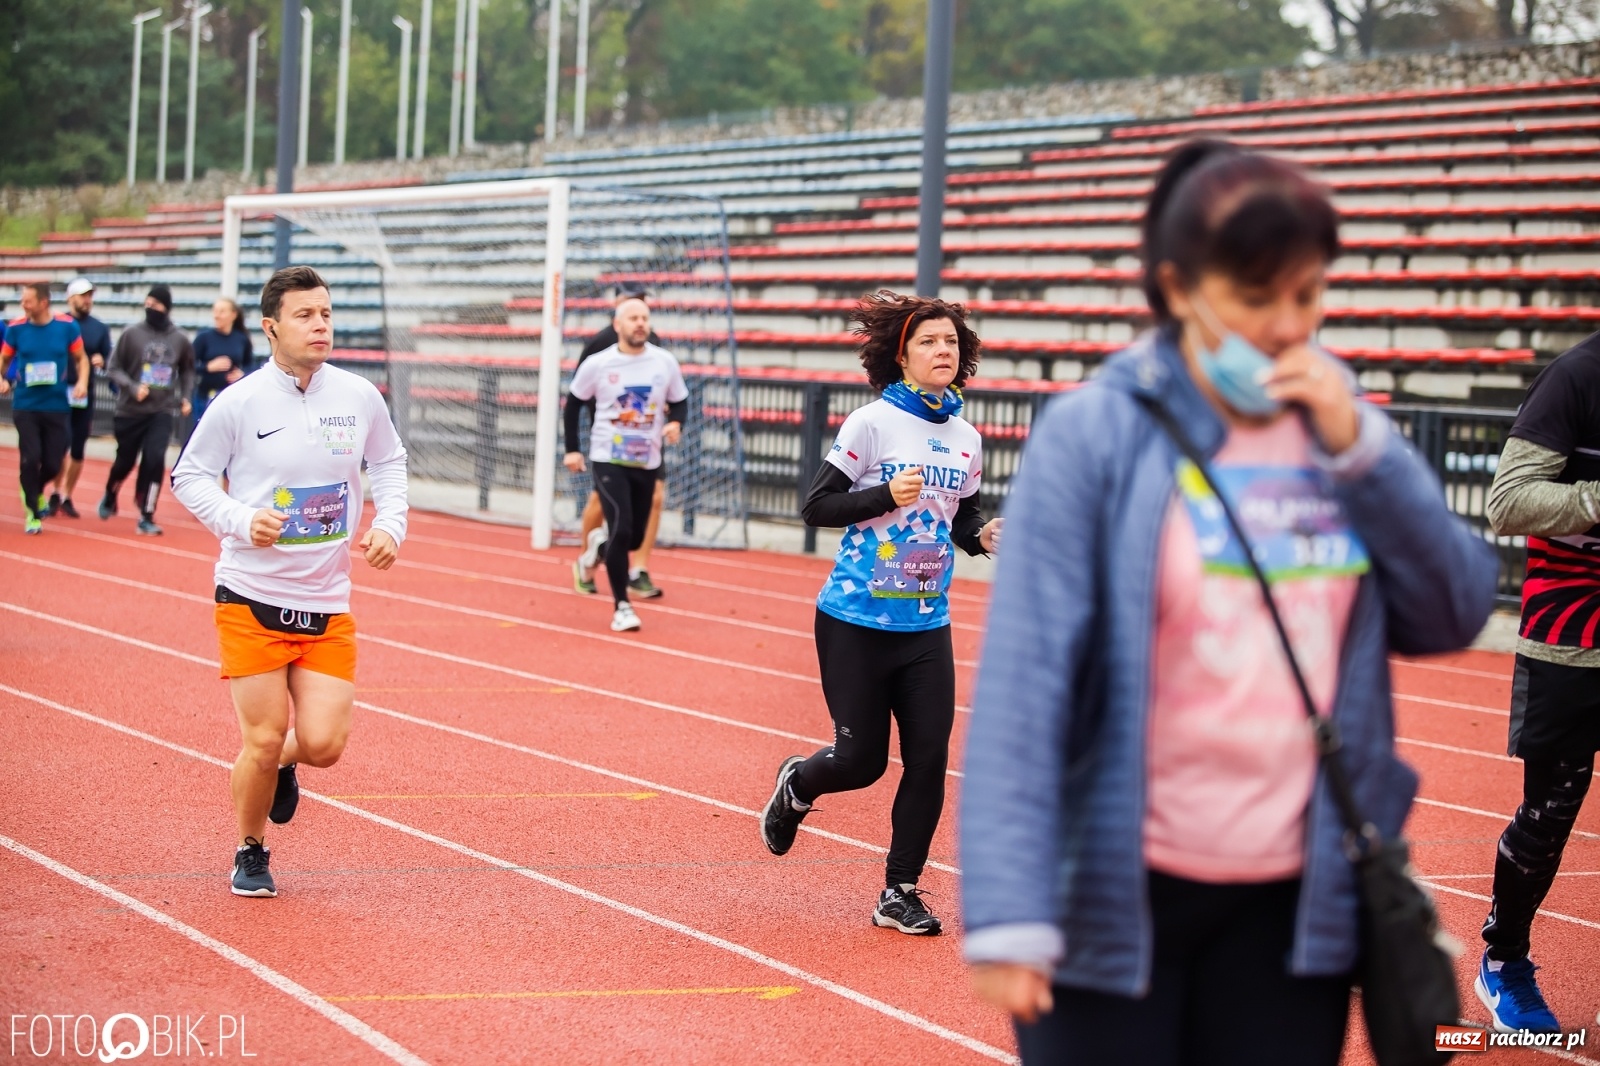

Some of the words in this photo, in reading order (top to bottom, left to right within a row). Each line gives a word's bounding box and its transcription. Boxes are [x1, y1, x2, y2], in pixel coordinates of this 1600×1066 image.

[320, 416, 356, 427] MATEUSZ
[304, 507, 317, 515] DLA
[320, 521, 342, 536] 299
[885, 561, 901, 569] BIEG
[904, 562, 917, 570] DLA
[918, 580, 937, 591] 103
